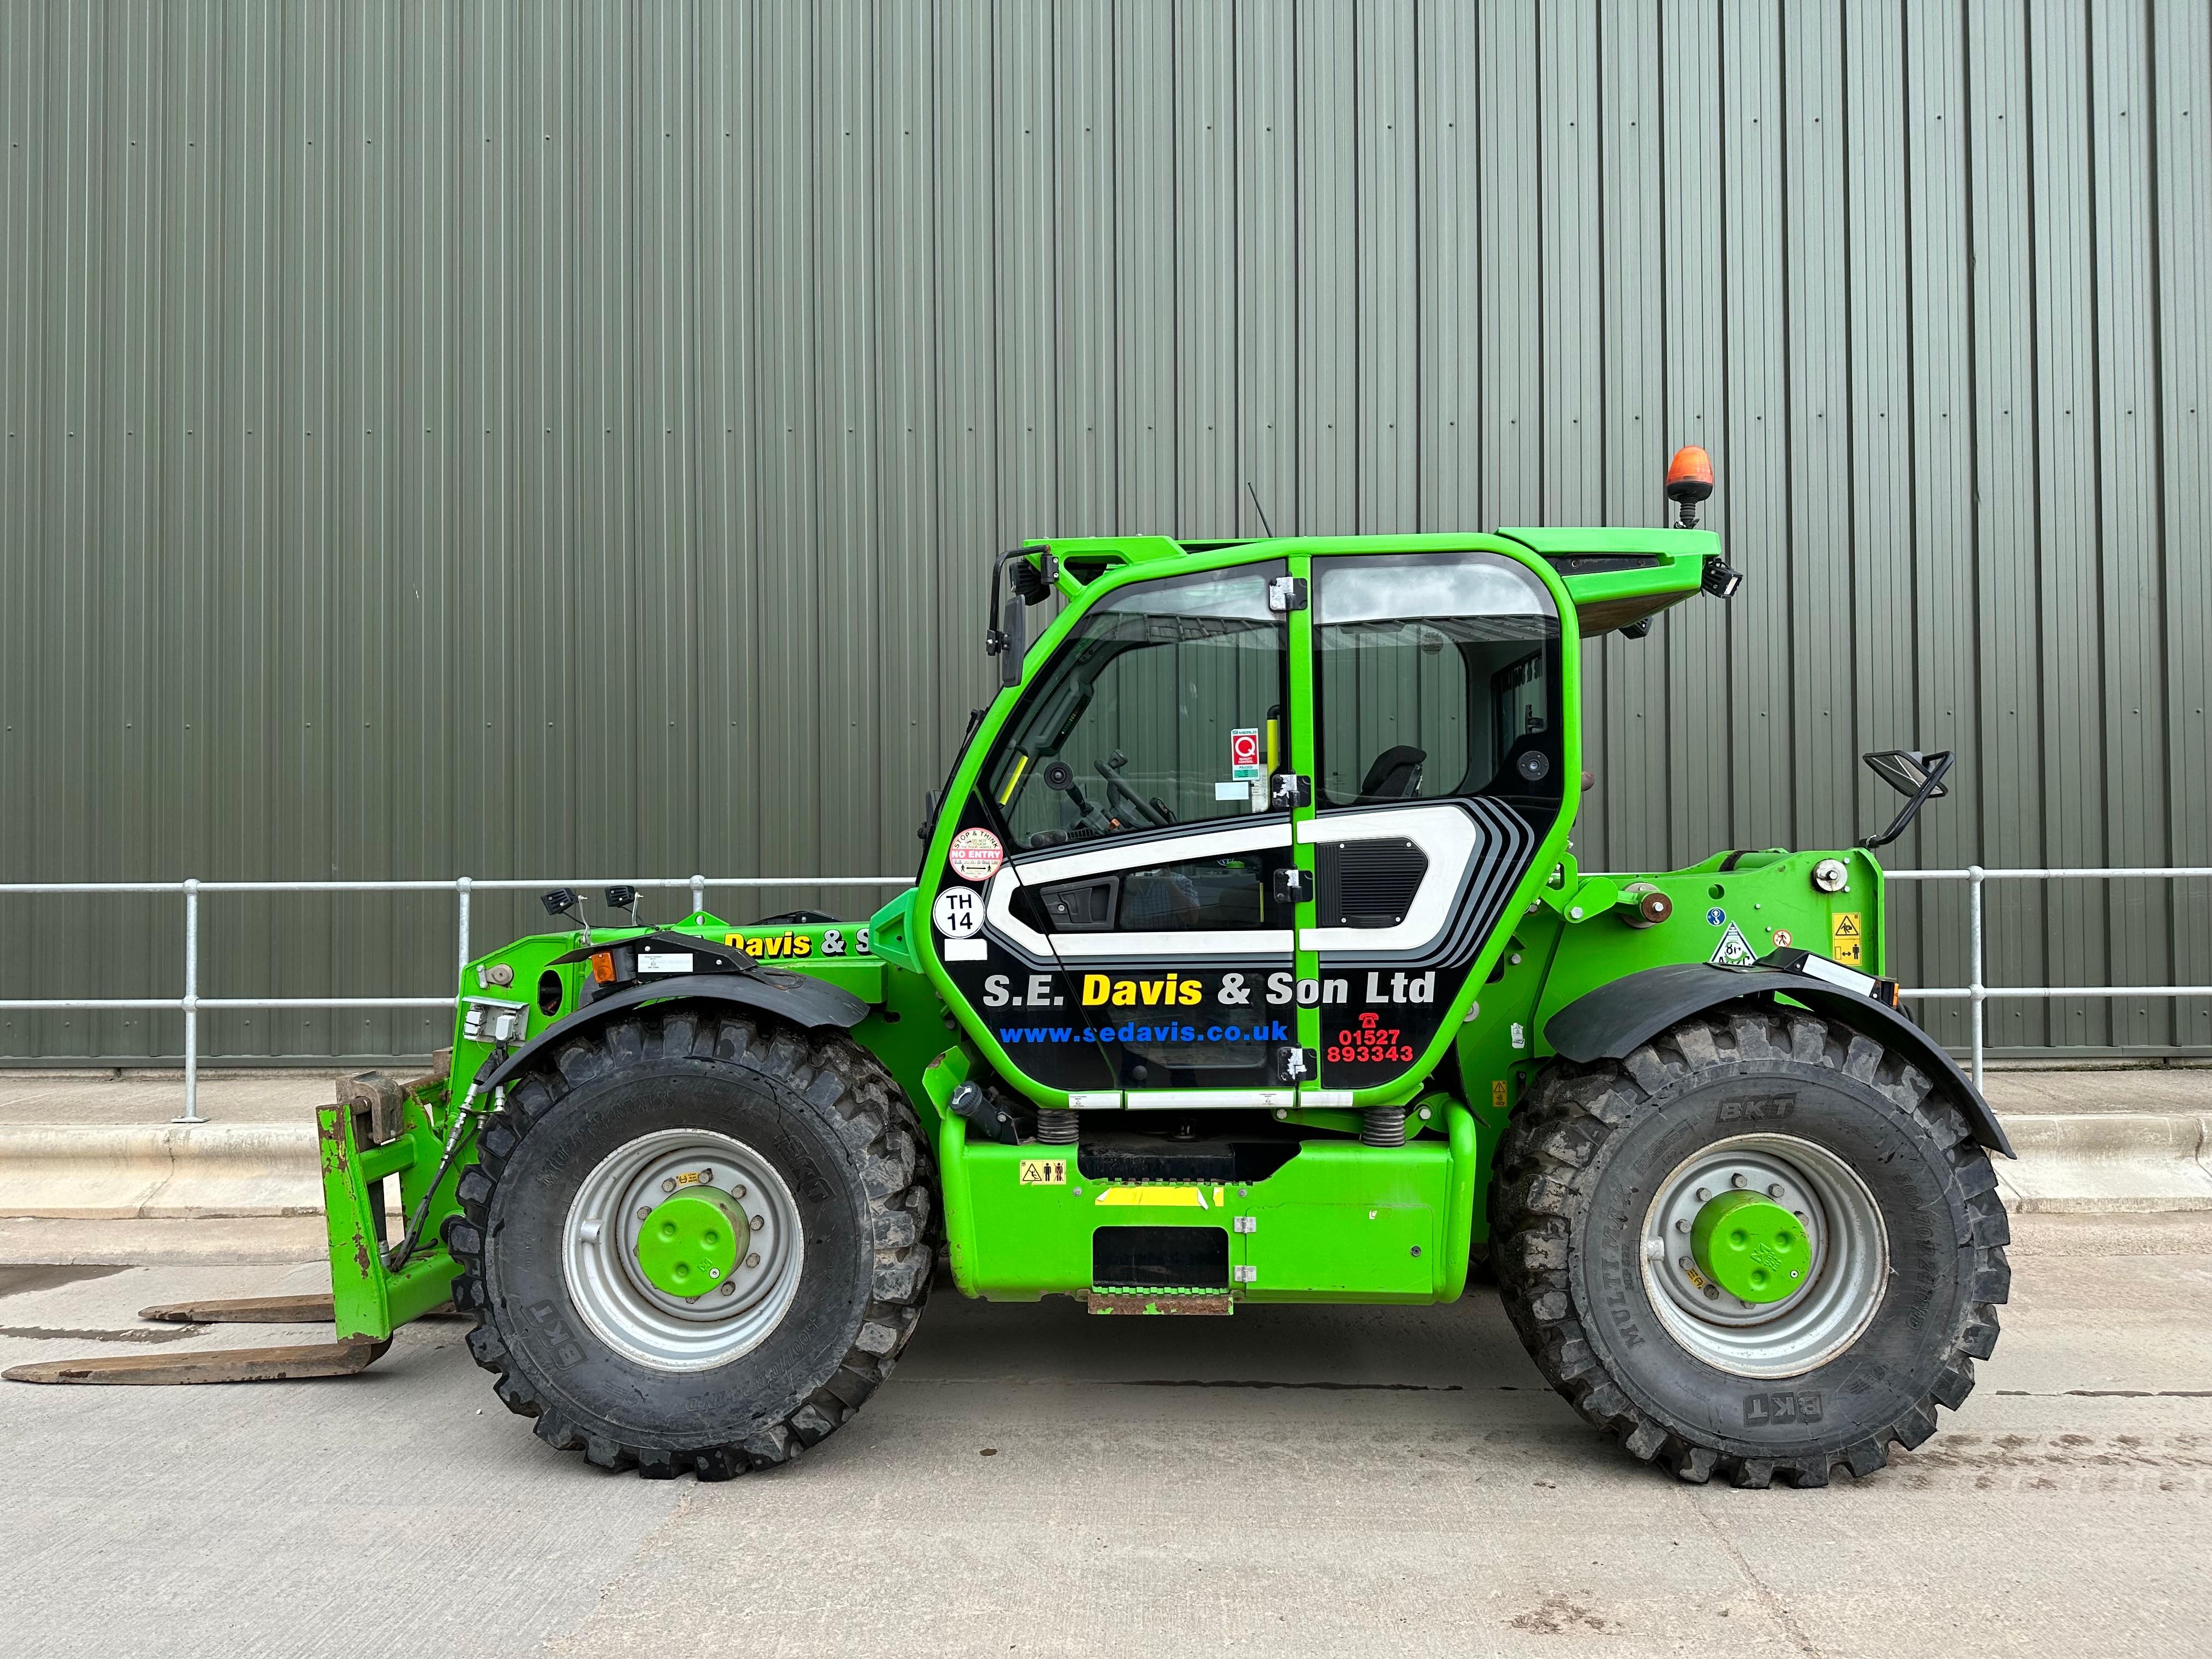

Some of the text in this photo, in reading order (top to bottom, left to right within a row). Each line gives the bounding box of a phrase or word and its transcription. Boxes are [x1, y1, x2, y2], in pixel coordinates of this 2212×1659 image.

[954, 832, 970, 849] STOP
[980, 831, 998, 849] THINK
[968, 850, 1001, 859] ENTRY
[946, 894, 972, 910] TH
[947, 912, 973, 931] 14
[724, 931, 811, 957] Davis
[821, 929, 844, 953] &
[983, 971, 1436, 1007] S.E. Davis & Son Ltd
[1000, 1020, 1288, 1043] www.sedavis.co.uk
[1339, 1029, 1400, 1046] 01527
[1327, 1046, 1413, 1062] 893343
[1718, 1095, 1795, 1121] BKT
[528, 1304, 584, 1367] BKT
[1746, 1394, 1821, 1421] BKT
